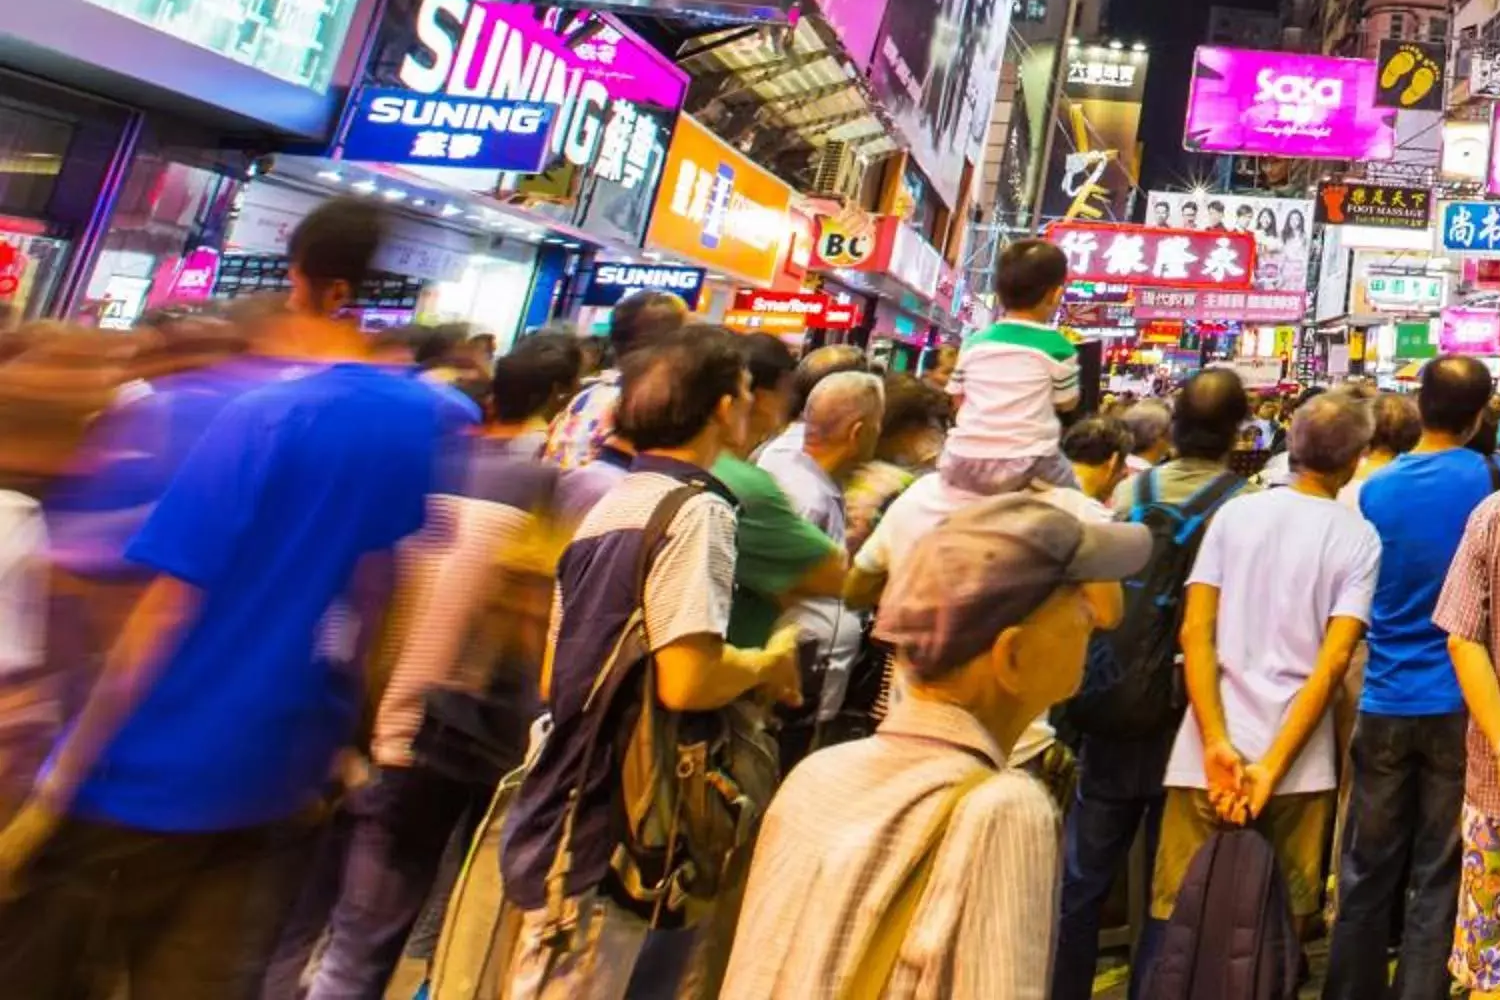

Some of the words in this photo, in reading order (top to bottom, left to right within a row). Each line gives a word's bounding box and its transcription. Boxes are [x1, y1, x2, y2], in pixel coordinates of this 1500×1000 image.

[368, 96, 545, 133] SUNING
[1347, 203, 1374, 214] FOOT
[1376, 205, 1425, 217] MASSAGE
[596, 266, 699, 289] SUNING
